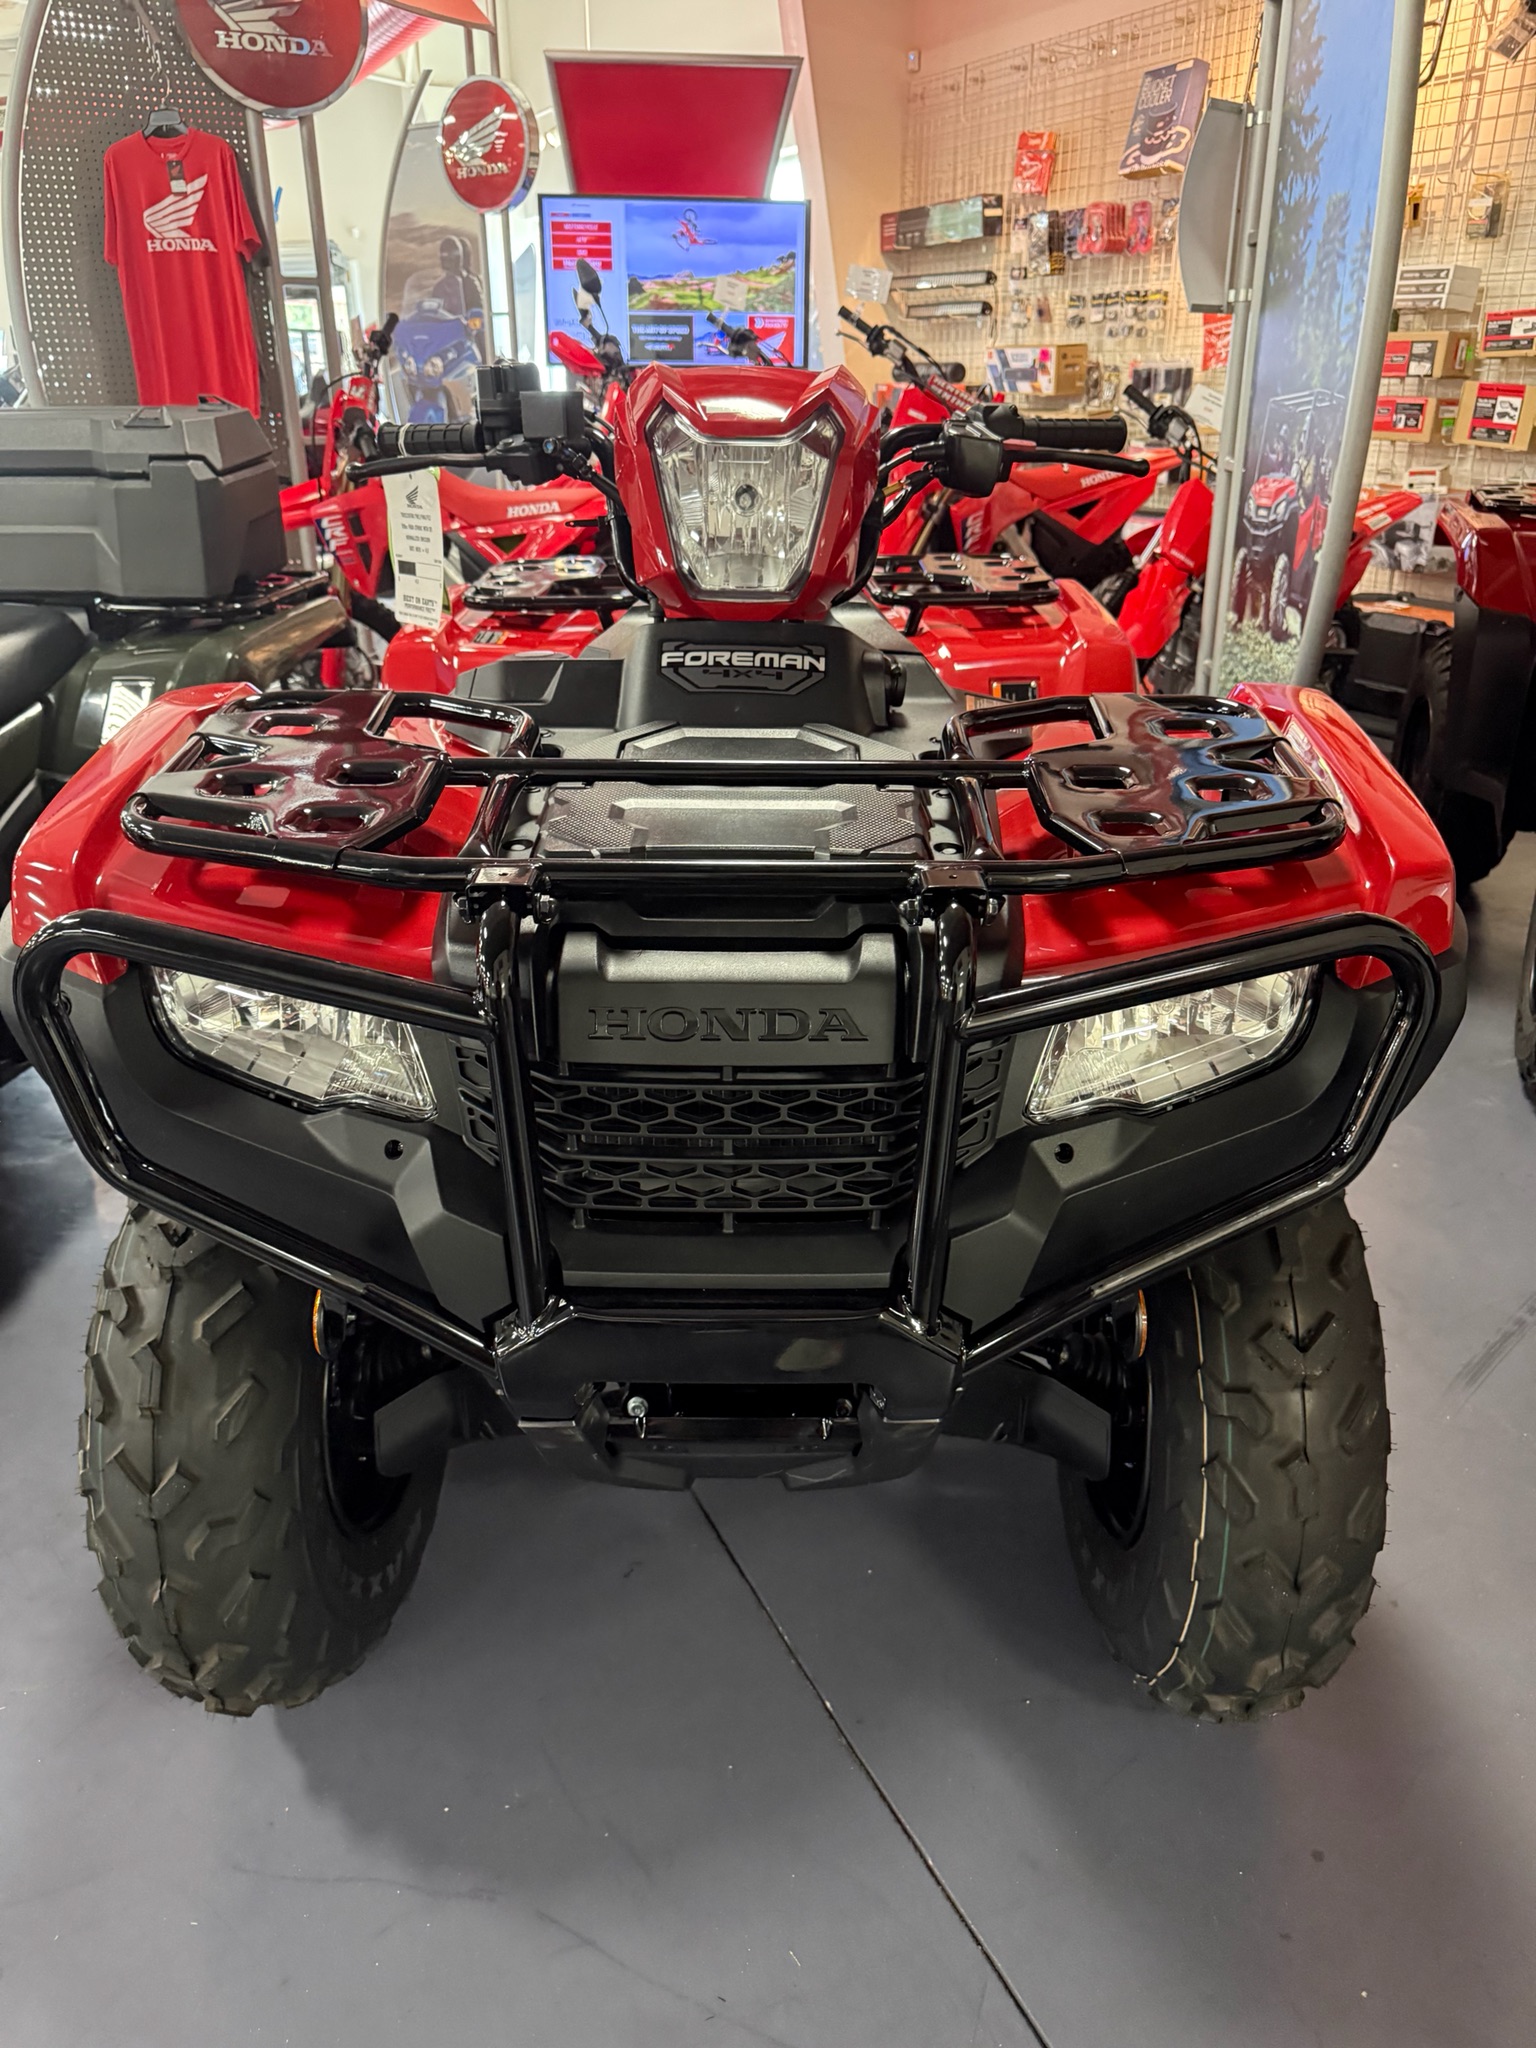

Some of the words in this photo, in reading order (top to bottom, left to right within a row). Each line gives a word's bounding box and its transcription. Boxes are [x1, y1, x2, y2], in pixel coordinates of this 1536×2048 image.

[214, 30, 333, 57] HONDA
[456, 162, 509, 179] HONDA
[146, 238, 218, 252] HONDA
[506, 501, 561, 518] HONDA
[661, 651, 826, 672] FOREMAN
[588, 1006, 869, 1042] HONDA
